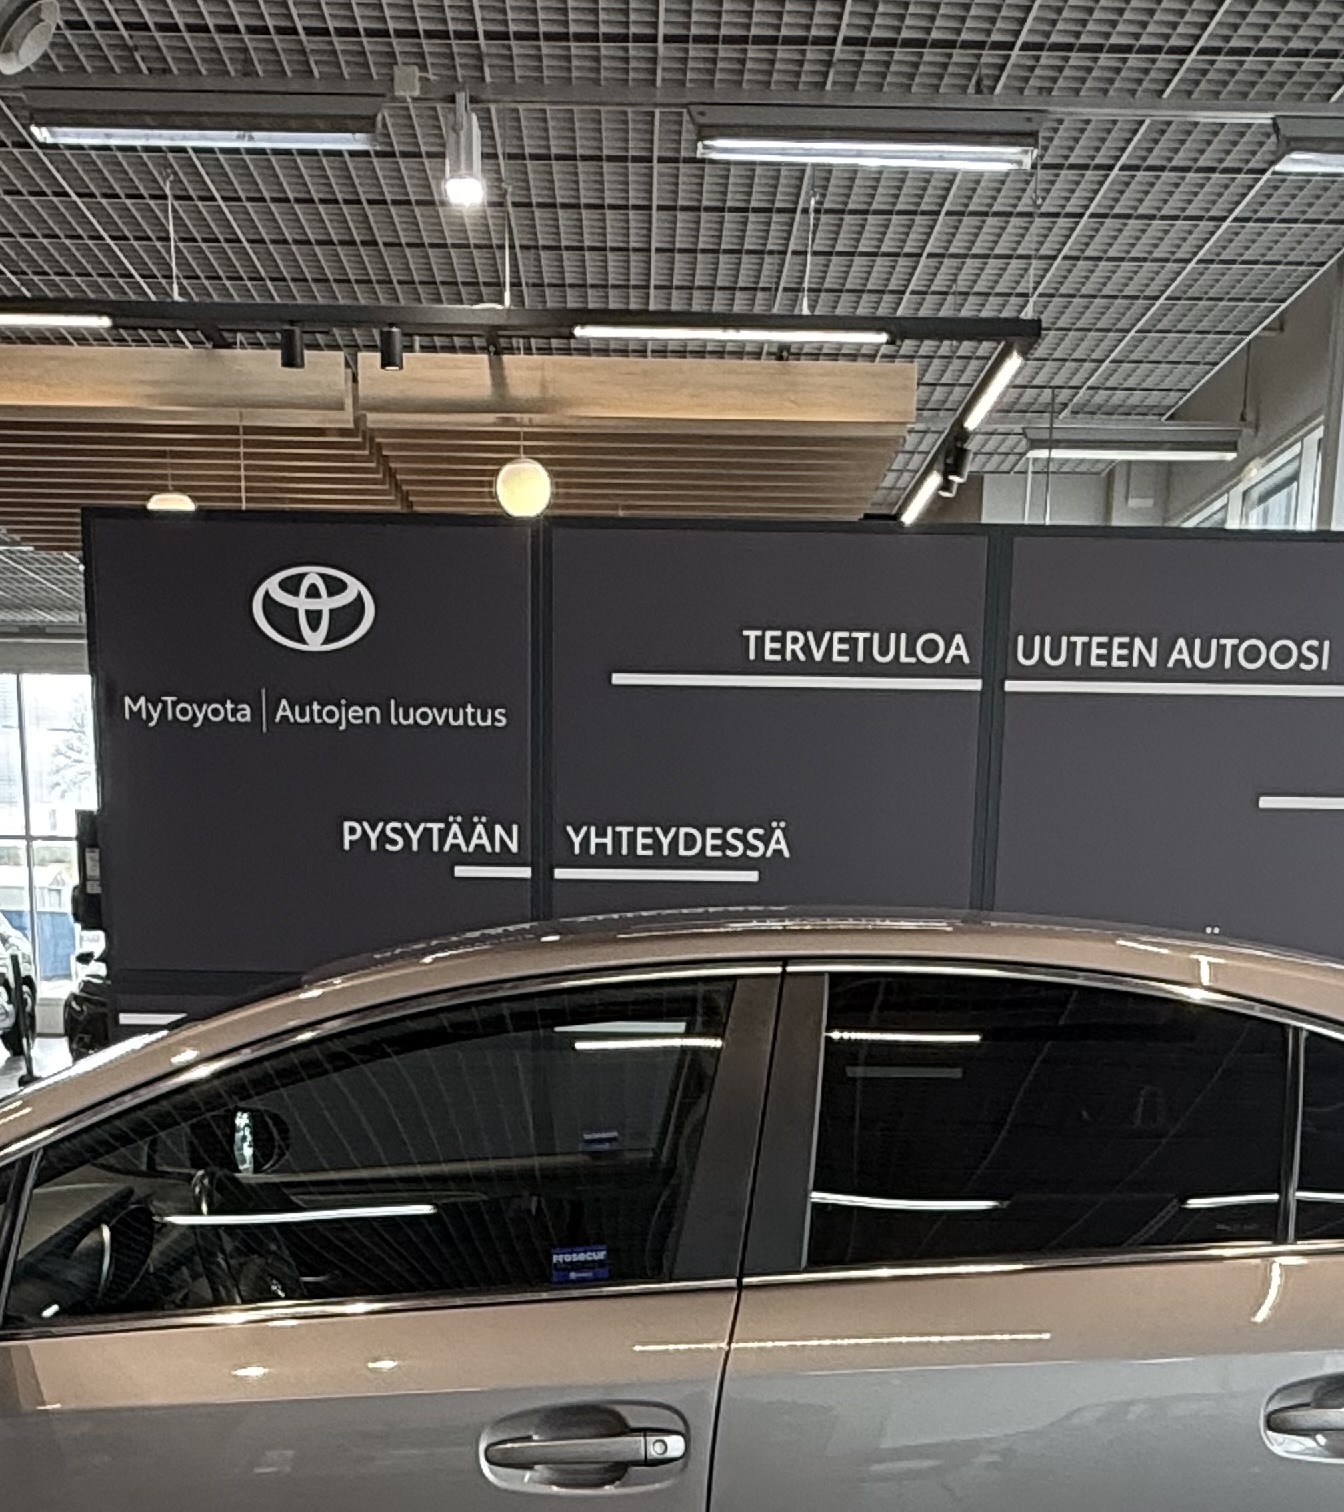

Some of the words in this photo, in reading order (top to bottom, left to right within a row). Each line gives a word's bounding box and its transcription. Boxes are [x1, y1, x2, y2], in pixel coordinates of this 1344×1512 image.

[742, 629, 971, 665] TERVETULOA
[1016, 634, 1158, 668] UUTEEN
[1166, 637, 1330, 672] AUTOOSI
[124, 696, 251, 728] MyToyota
[274, 698, 381, 731] Autojen
[390, 698, 507, 728] luovutus
[343, 815, 518, 854] PYSYTÄÄN
[566, 820, 790, 859] YHTEYDESSÄ
